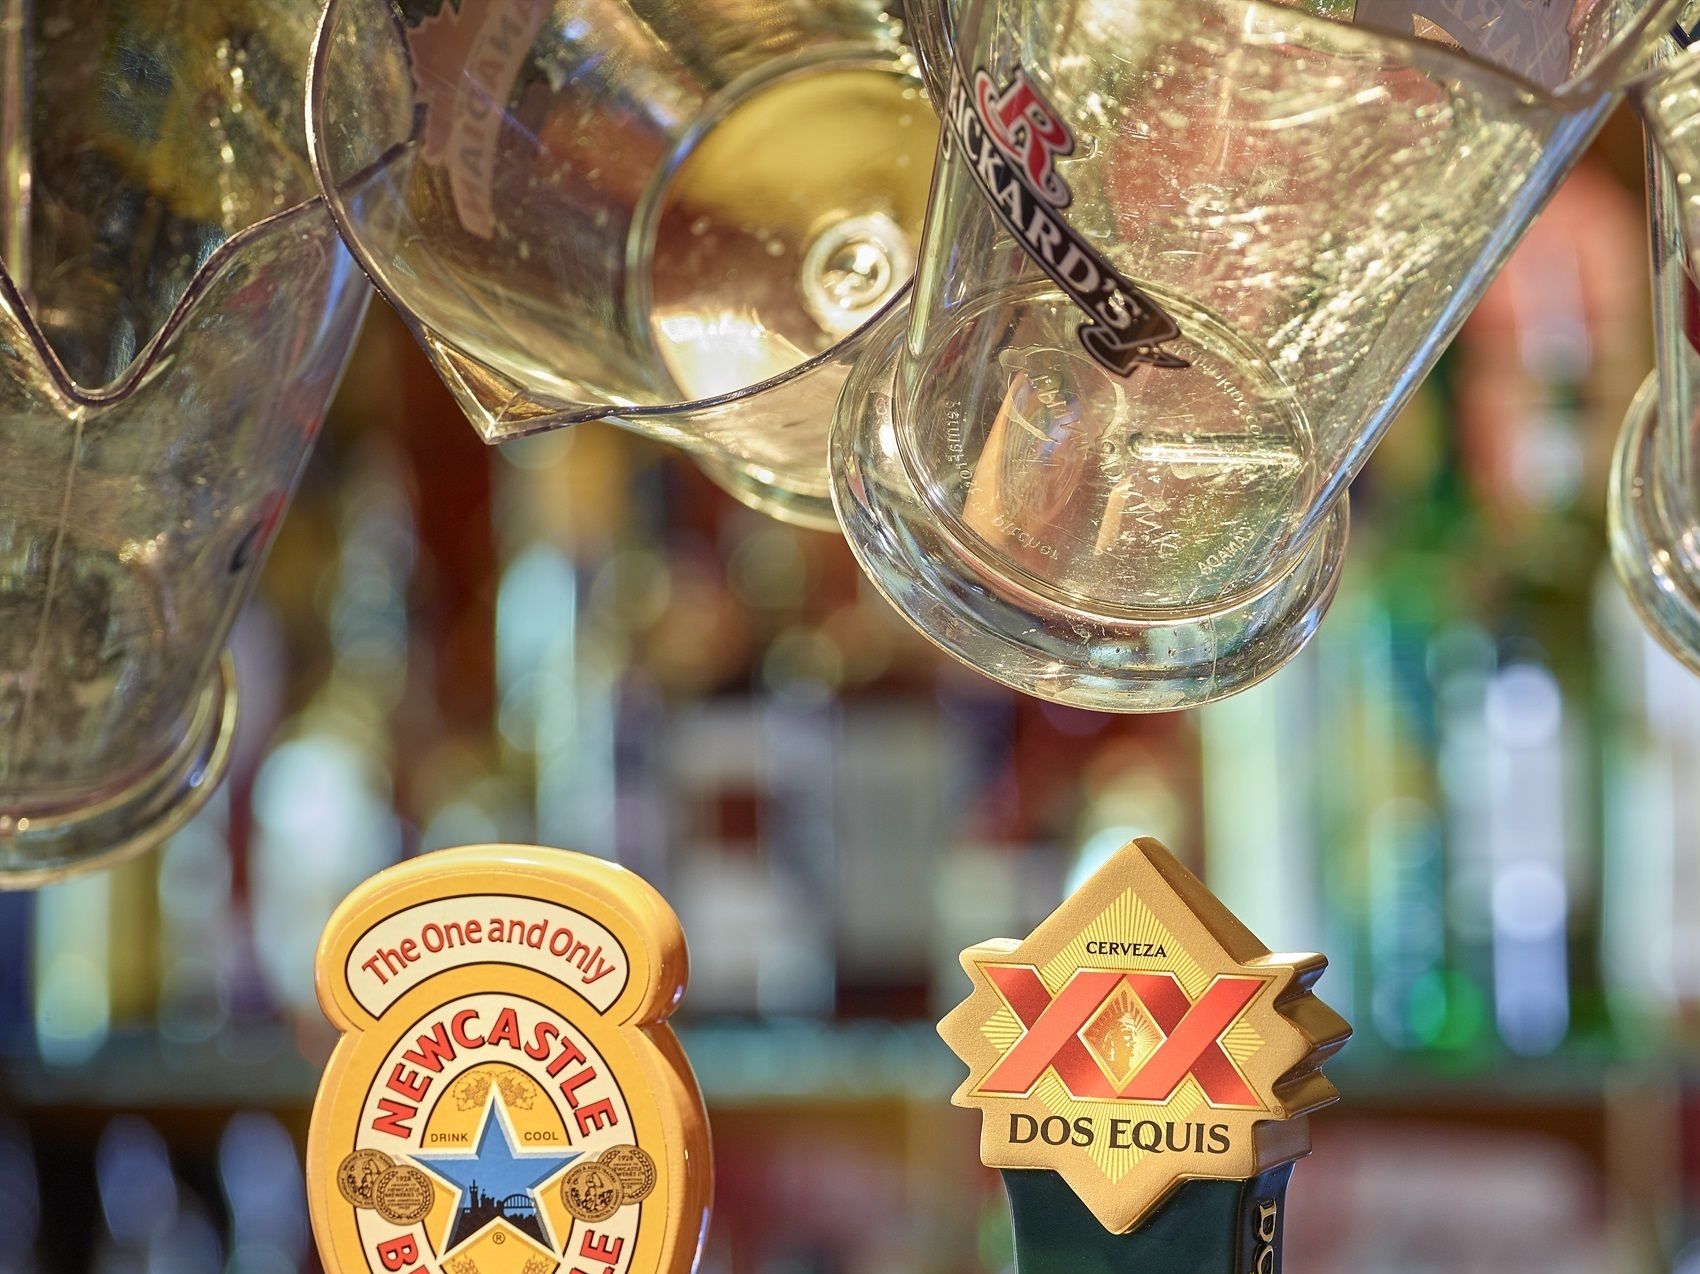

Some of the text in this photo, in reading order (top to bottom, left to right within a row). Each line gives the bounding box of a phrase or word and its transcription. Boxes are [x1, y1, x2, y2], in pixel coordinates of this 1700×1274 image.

[361, 917, 616, 985] The One and Only
[1085, 940, 1168, 959] CERVEZA
[371, 1006, 620, 1139] NEWCASTLE
[430, 1132, 469, 1143] DRINK
[523, 1131, 559, 1142] COOL
[1008, 1112, 1231, 1155] DOS EQUIS
